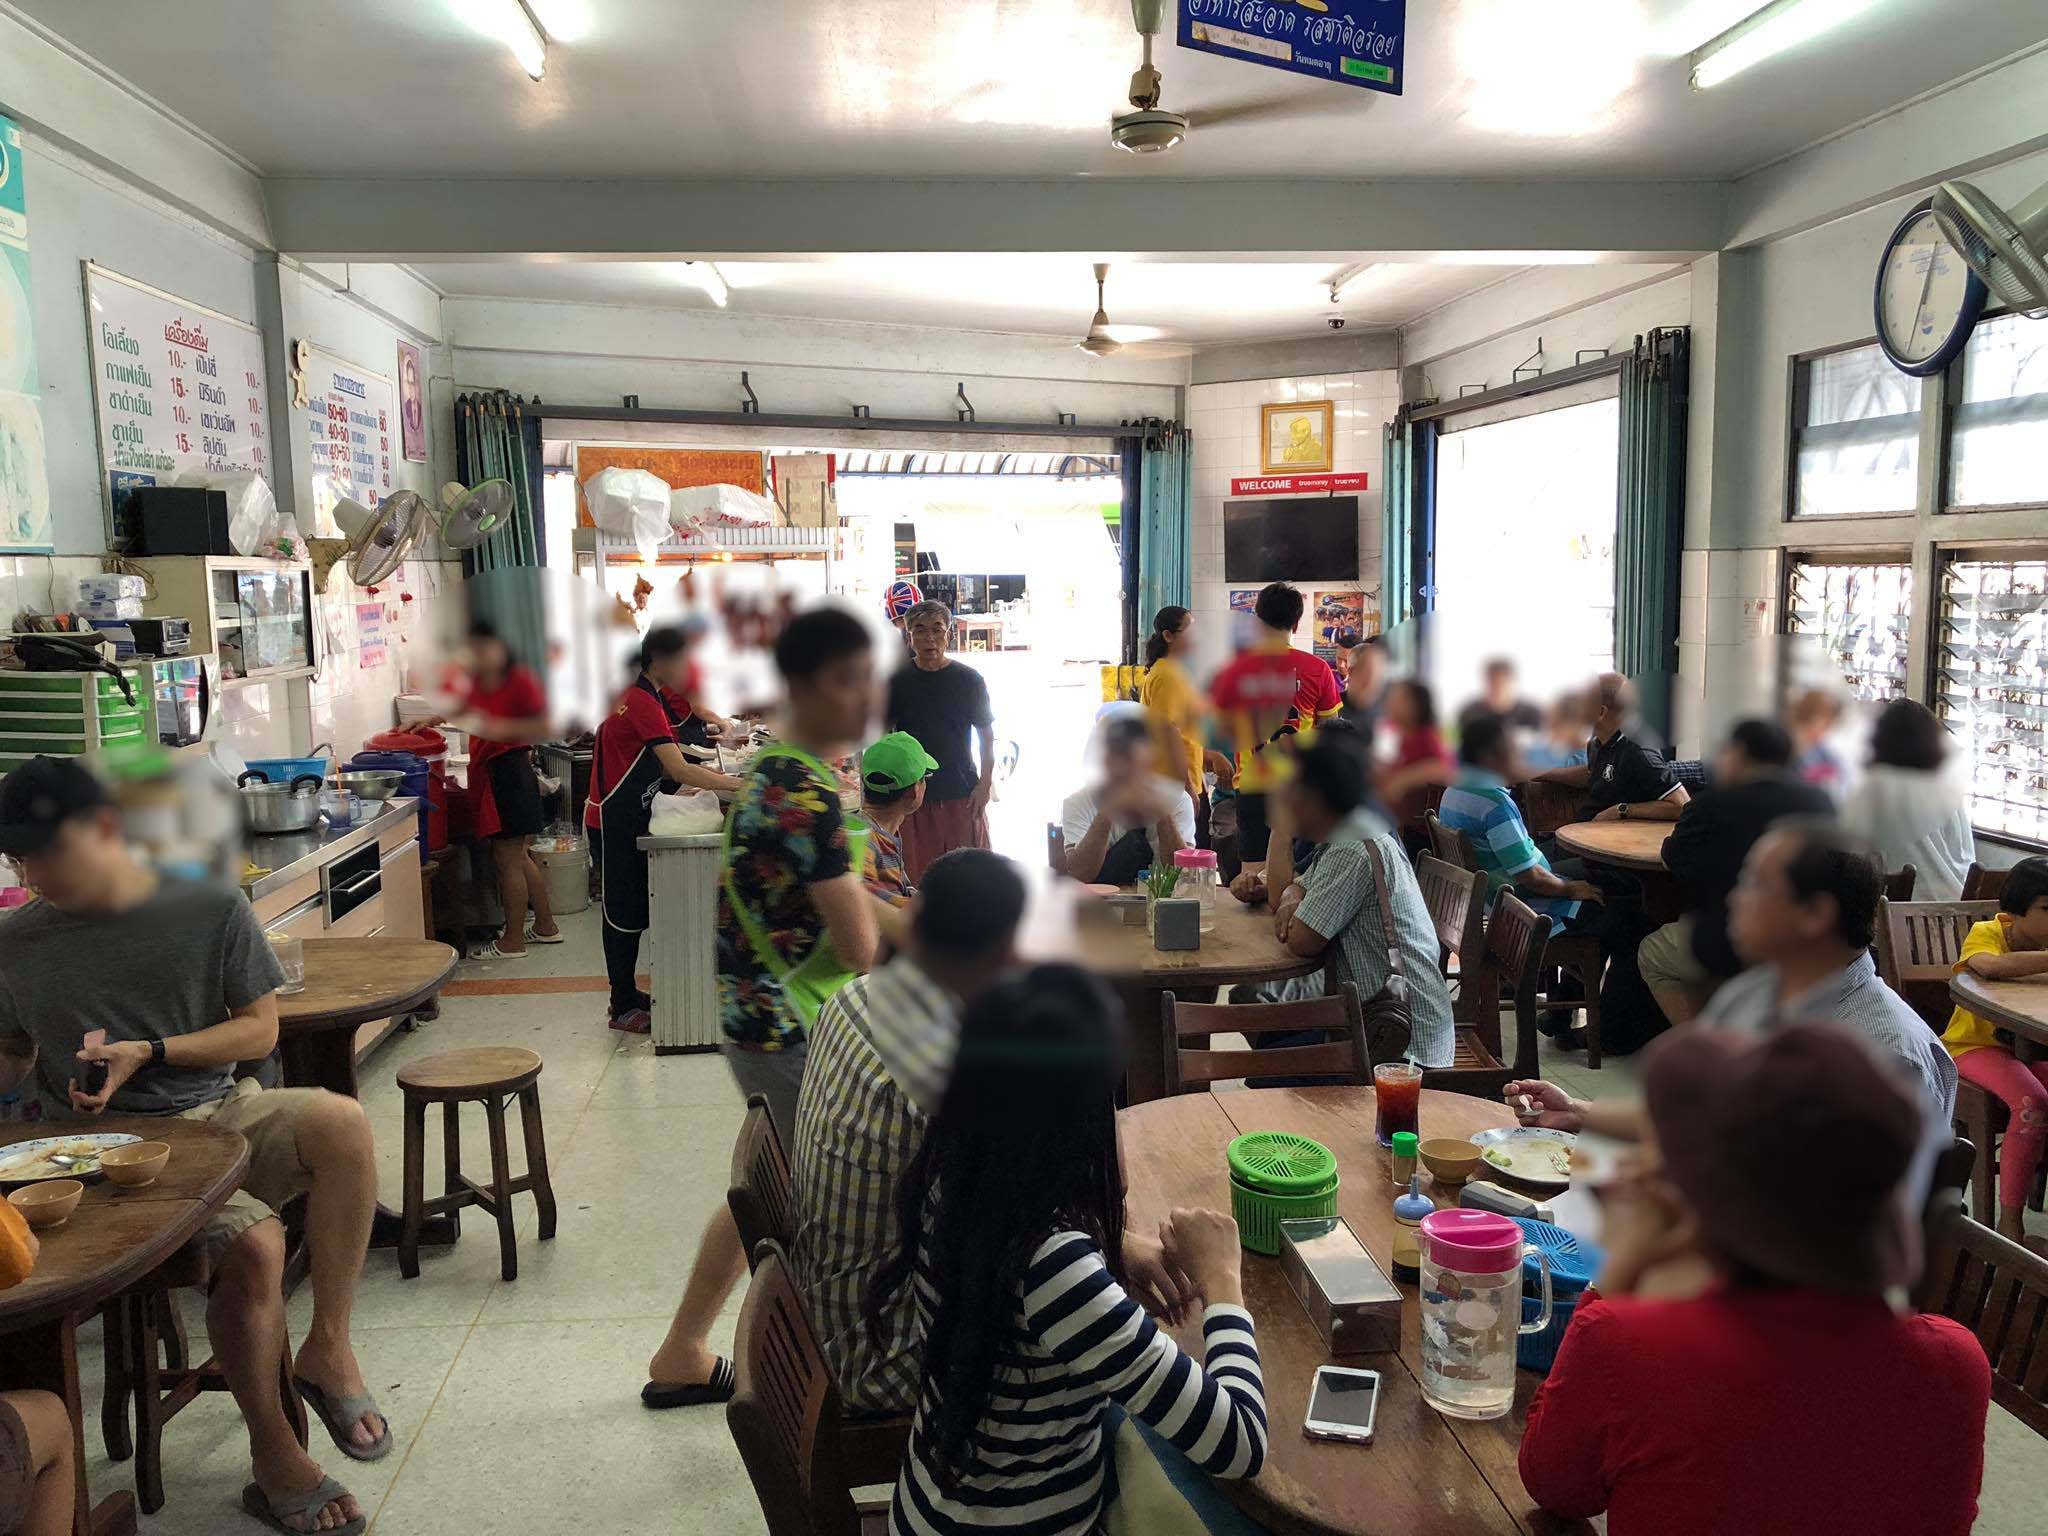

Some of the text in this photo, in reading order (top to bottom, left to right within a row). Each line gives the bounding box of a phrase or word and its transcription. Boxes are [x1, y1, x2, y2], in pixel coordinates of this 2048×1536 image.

[1188, 0, 1297, 34] อาหารสะอาด
[1303, 15, 1399, 60] รสชาติอร่อย
[102, 322, 140, 356] โอเลี้ยง
[164, 317, 209, 350] เครื่องดื่ม
[106, 362, 153, 389] กาแฟเย็น
[112, 421, 144, 444] ชาเย็น
[1239, 479, 1292, 491] WELCOME
